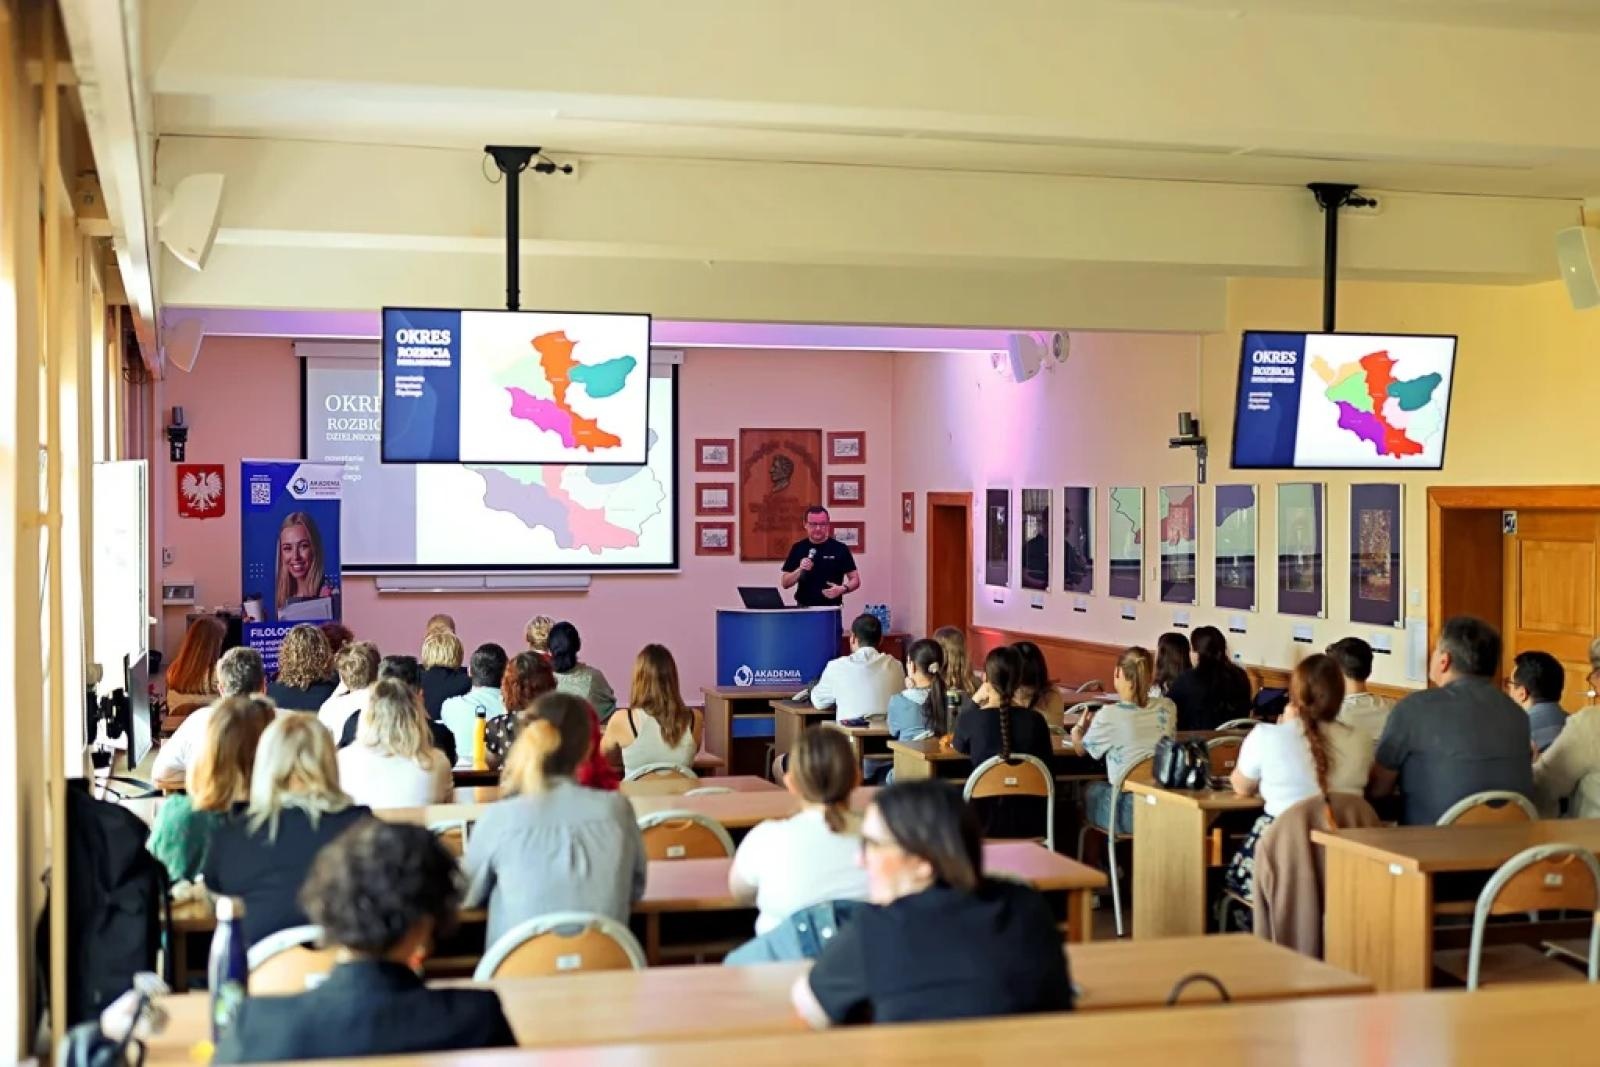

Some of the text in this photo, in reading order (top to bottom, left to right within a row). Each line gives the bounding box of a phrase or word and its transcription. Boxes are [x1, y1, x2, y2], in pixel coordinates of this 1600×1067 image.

[396, 329, 451, 345] OKRES
[1252, 350, 1297, 364] OKRES
[754, 669, 801, 677] AKADEMIA
